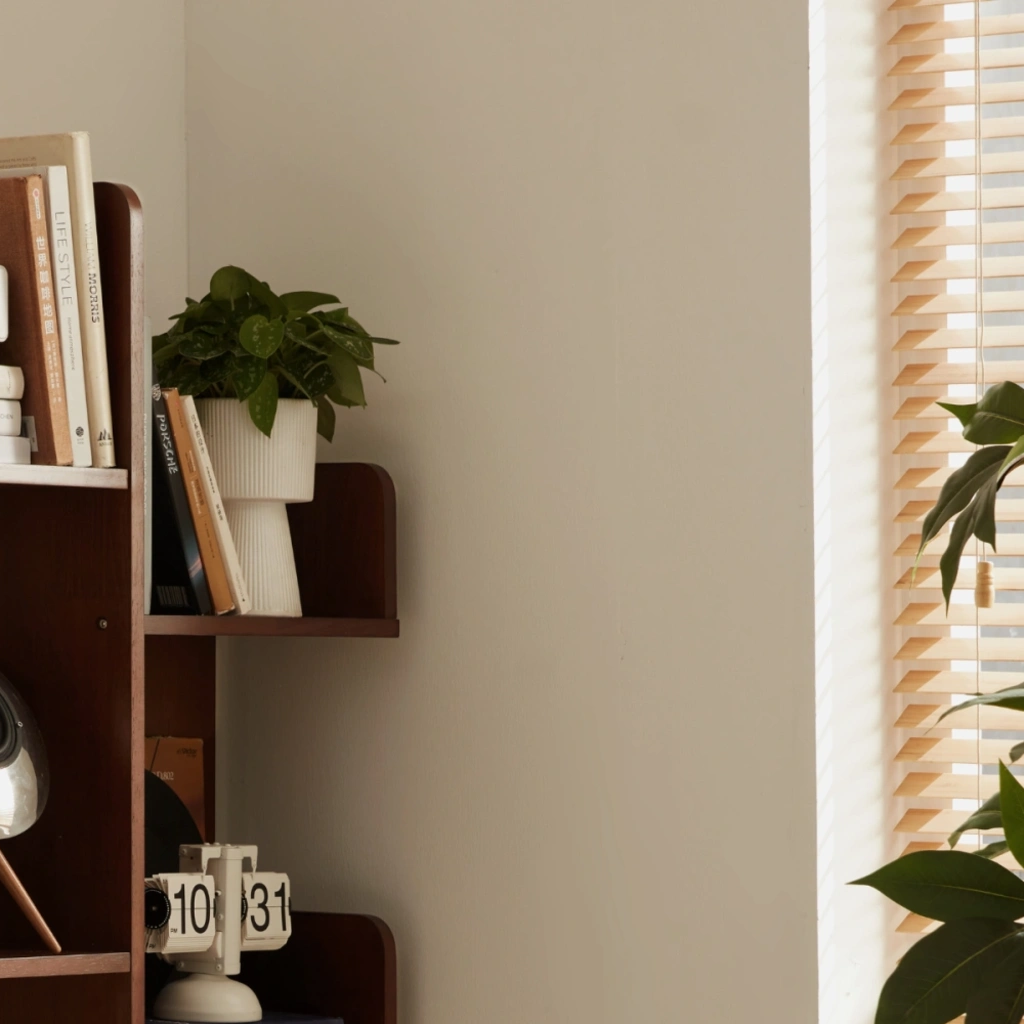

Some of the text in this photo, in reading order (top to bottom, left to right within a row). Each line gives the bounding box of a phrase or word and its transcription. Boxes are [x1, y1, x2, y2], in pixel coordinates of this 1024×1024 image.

[36, 236, 54, 335] 世界咖啡地图
[54, 211, 73, 306] LIFE STYLE
[88, 273, 100, 323] MORRIS
[156, 414, 178, 475] PORSCHE
[174, 881, 288, 934] 10 31
